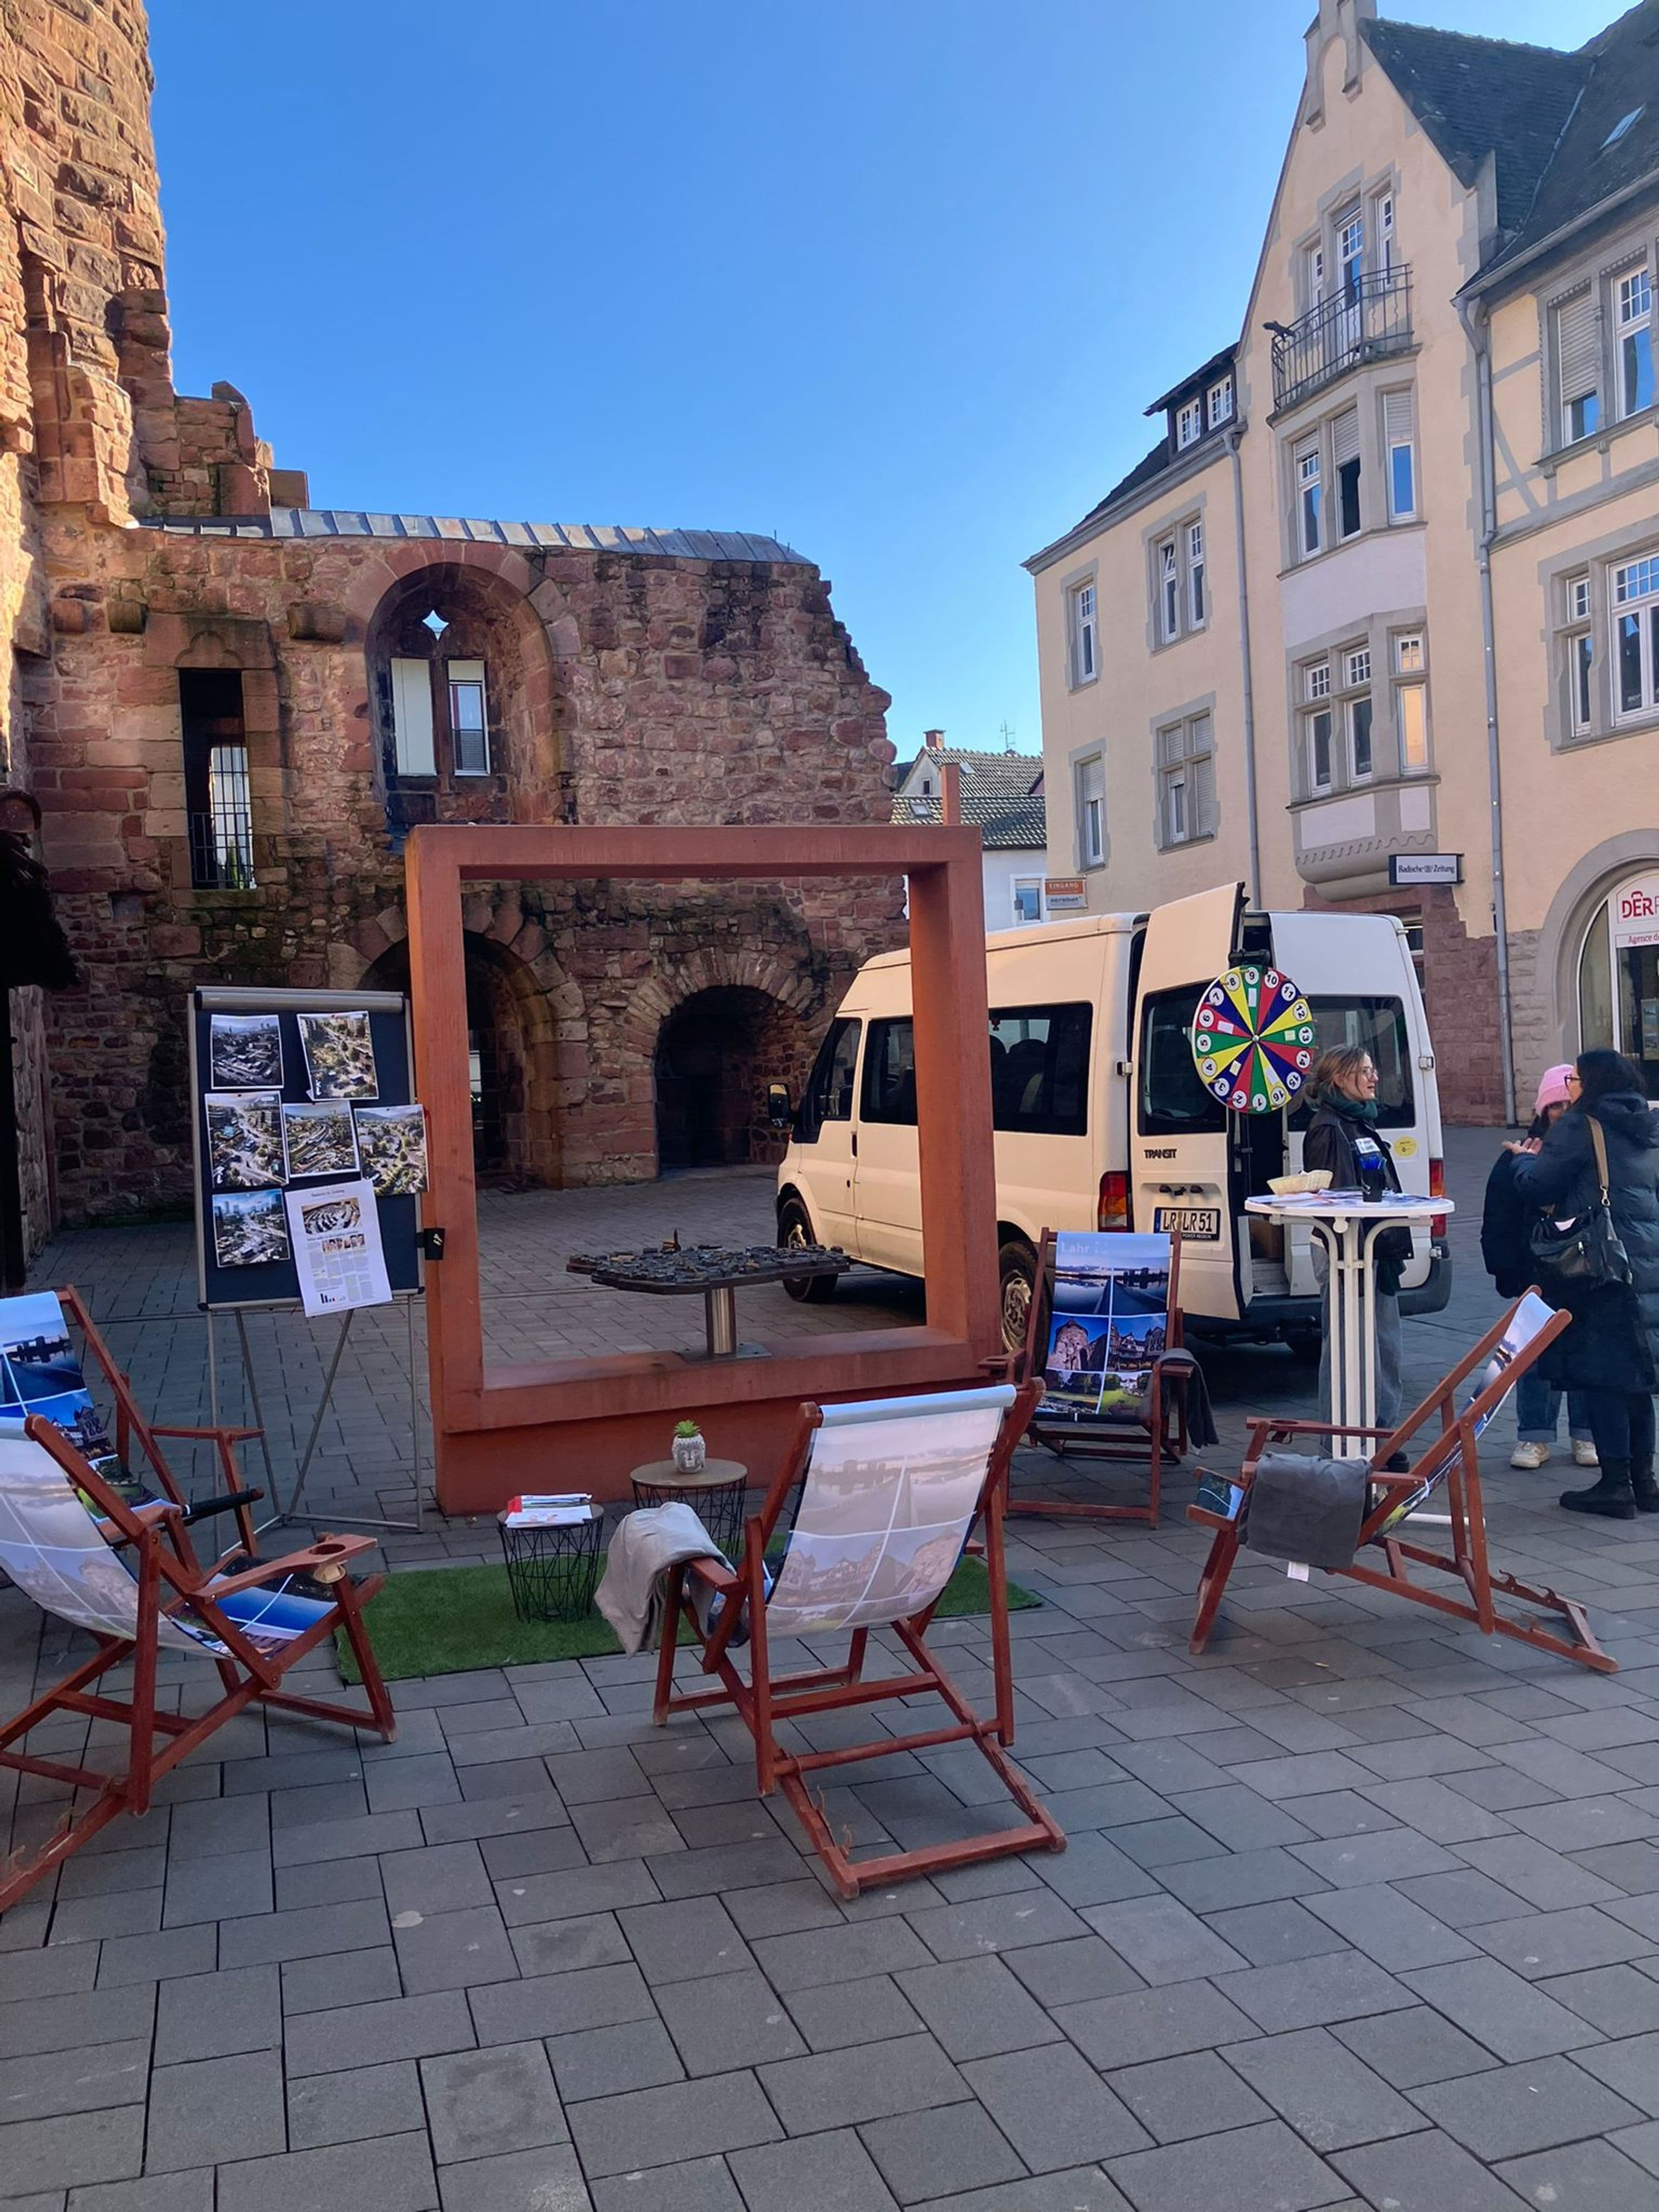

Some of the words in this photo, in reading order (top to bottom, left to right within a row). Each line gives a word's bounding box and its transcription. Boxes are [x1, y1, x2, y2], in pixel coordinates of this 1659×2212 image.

[1629, 935, 1652, 945] Agence
[1249, 972, 1255, 980] 9
[1266, 974, 1277, 983] 10
[1229, 977, 1236, 986] 8
[1213, 993, 1220, 1001] 7
[1284, 987, 1293, 998] 11
[1296, 1005, 1305, 1018] 12
[1302, 1029, 1310, 1042] 13
[1298, 1053, 1307, 1066] 14
[1288, 1075, 1299, 1088] 15
[1218, 1083, 1226, 1092] 3
[1236, 1095, 1243, 1104] 2
[1273, 1091, 1284, 1102] 16
[1144, 1149, 1177, 1159] TRANSIT
[1182, 1212, 1196, 1232] LR
[1199, 1212, 1212, 1232] 51
[1061, 1242, 1089, 1253] Lahr
